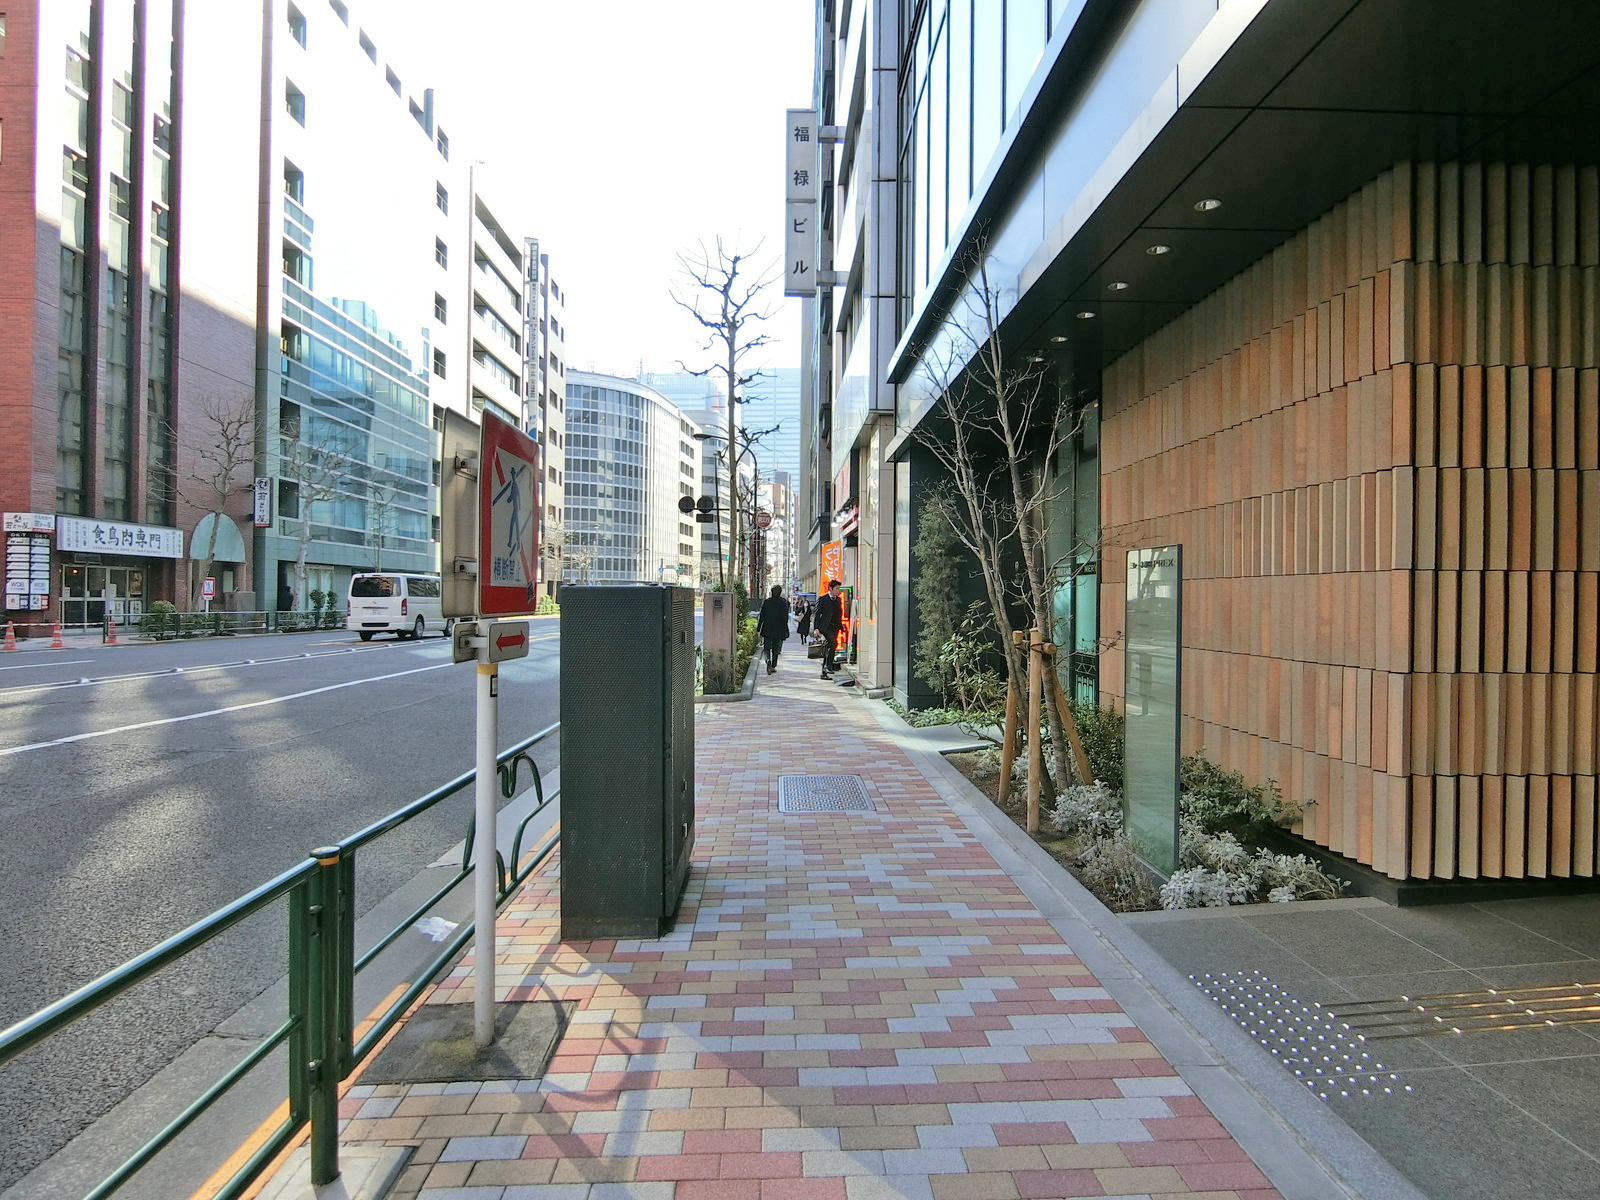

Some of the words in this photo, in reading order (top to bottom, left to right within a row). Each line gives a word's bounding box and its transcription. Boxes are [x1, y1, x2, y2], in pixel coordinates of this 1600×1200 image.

[793, 126, 810, 275] 福禄ビル
[92, 524, 161, 549] 食鳥肉専門
